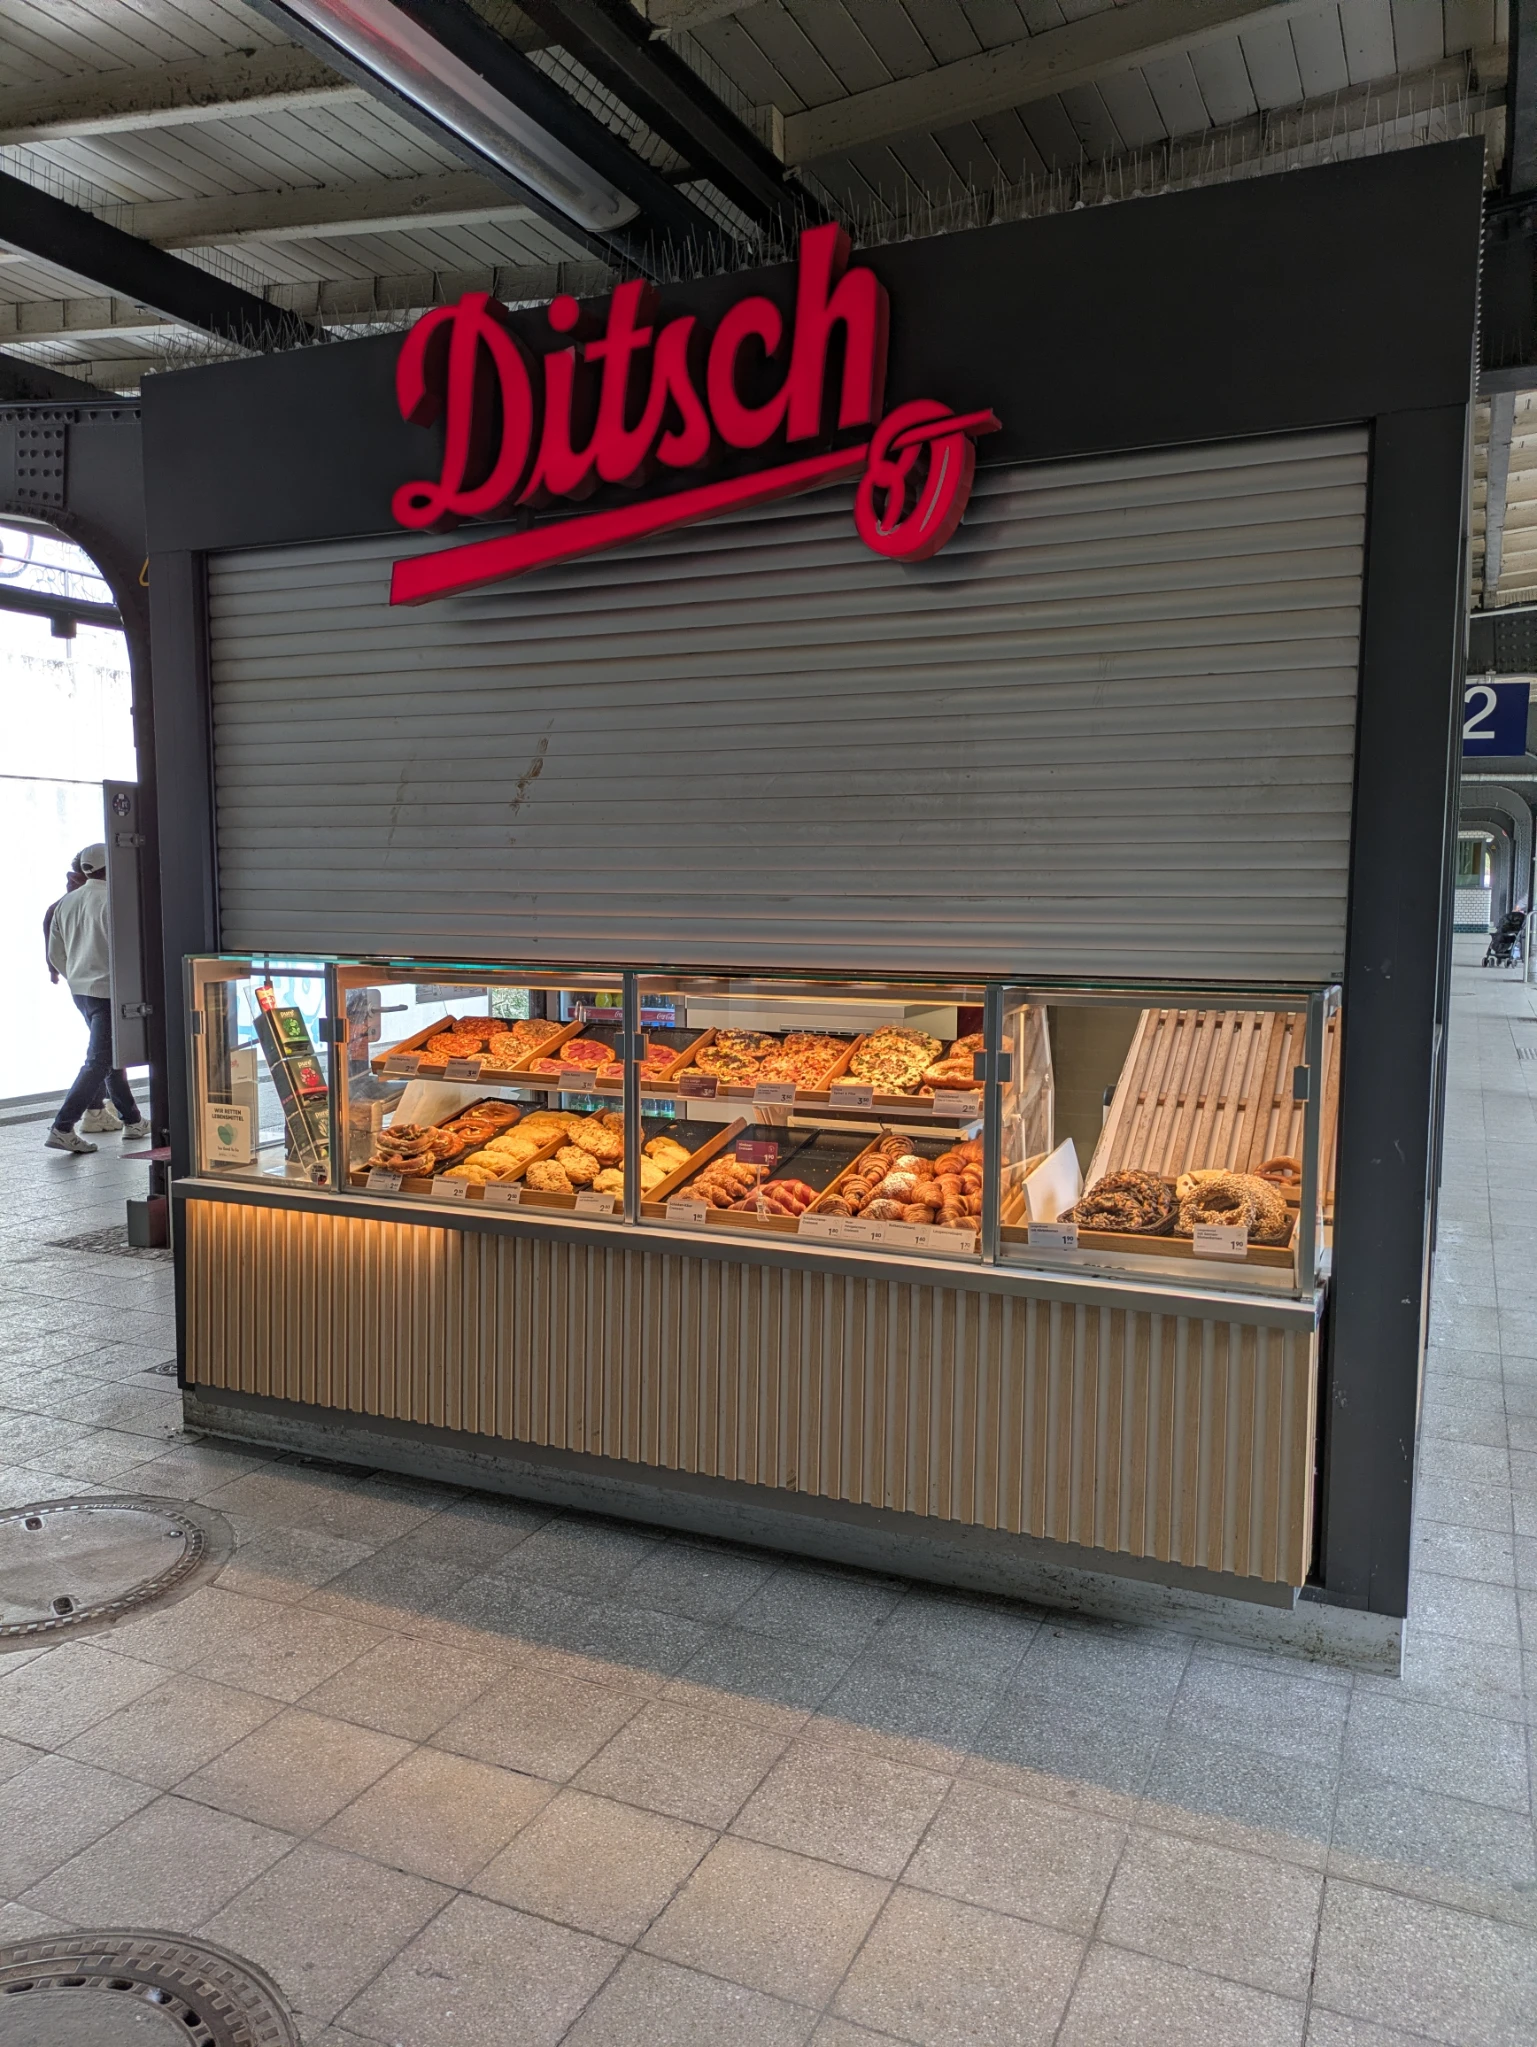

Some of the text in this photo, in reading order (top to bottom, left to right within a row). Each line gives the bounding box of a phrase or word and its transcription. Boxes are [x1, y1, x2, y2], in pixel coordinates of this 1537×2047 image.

[392, 221, 886, 531] Ditsch
[1463, 686, 1497, 739] 2
[211, 1113, 244, 1122] LEBENSMITTEL
